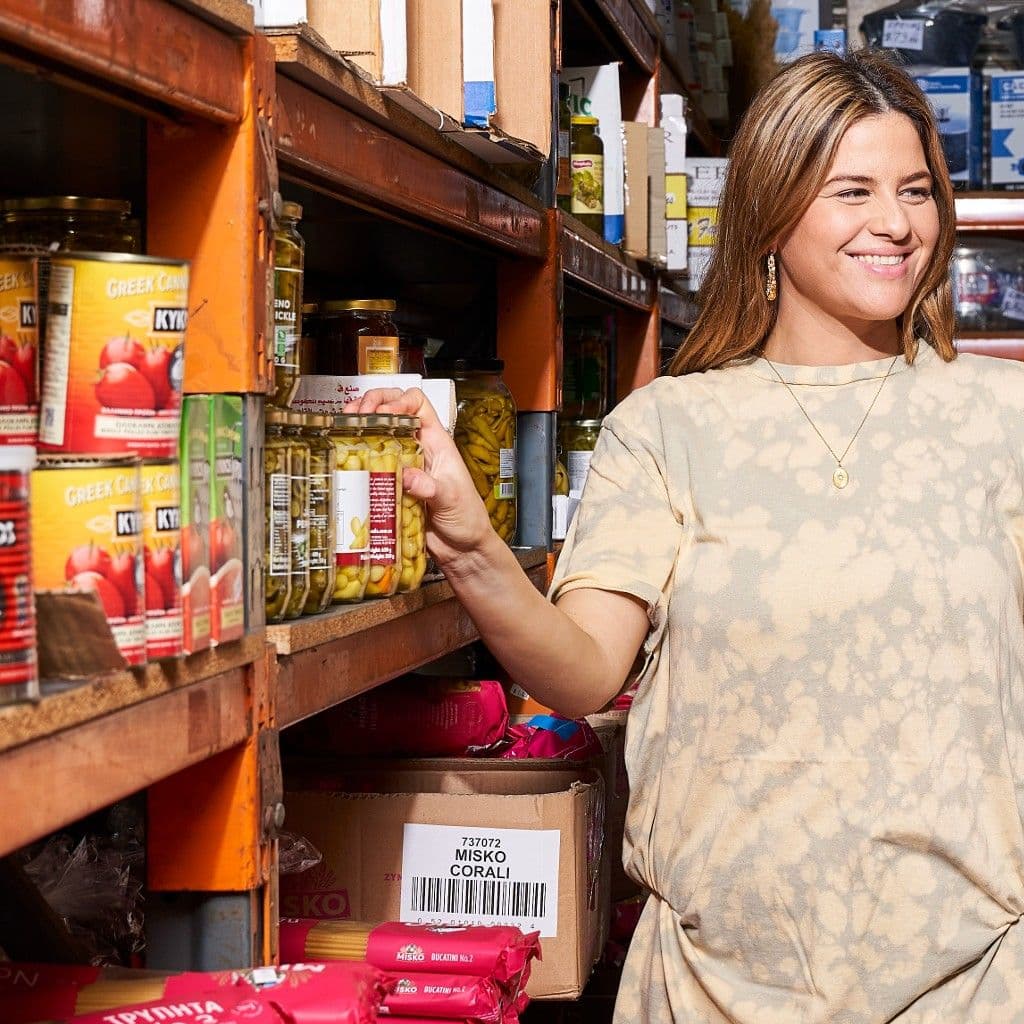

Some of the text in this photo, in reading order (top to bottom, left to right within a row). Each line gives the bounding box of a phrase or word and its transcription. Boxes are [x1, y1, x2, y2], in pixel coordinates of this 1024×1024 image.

[106, 271, 188, 298] GREEK CANN
[155, 308, 187, 331] KYK
[275, 312, 297, 321] ICKLE
[461, 837, 501, 848] 737072
[455, 848, 507, 864] MISKO
[450, 864, 511, 880] CORALI
[396, 953, 425, 962] MISKO
[431, 952, 459, 962] BUCATINI
[395, 985, 418, 994] ISKO
[423, 985, 452, 995] BUCATINI
